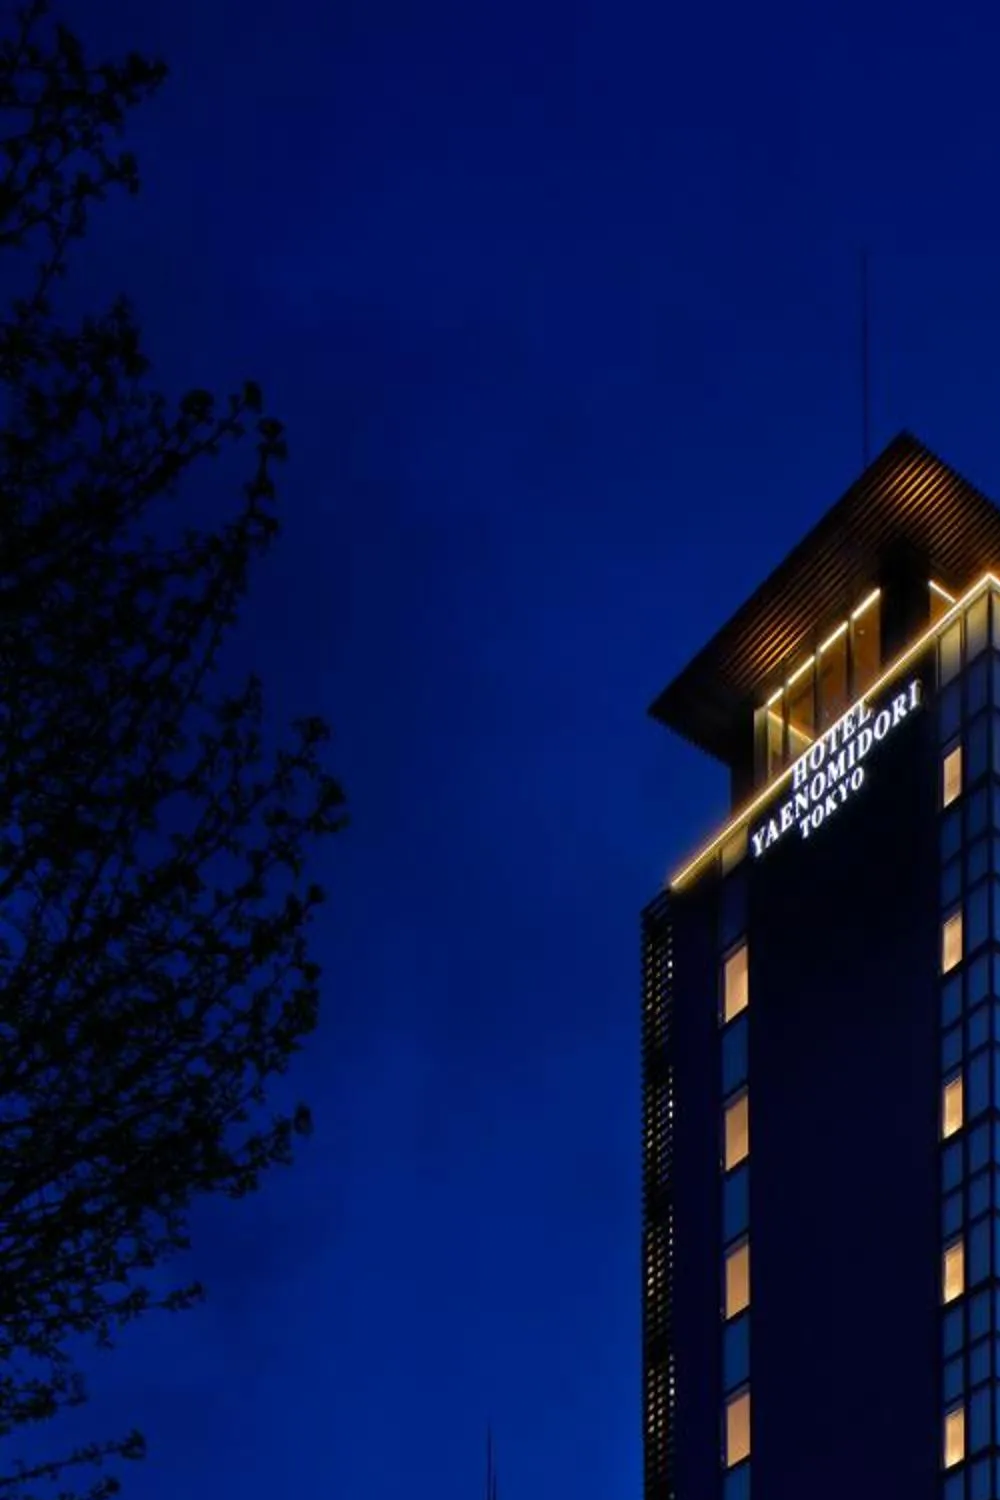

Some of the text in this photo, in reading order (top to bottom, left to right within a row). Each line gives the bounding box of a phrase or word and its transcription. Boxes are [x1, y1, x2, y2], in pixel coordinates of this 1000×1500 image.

[751, 679, 923, 857] YAENOMIDORI
[793, 700, 873, 788] HOTEL
[799, 767, 865, 839] TOKYO
